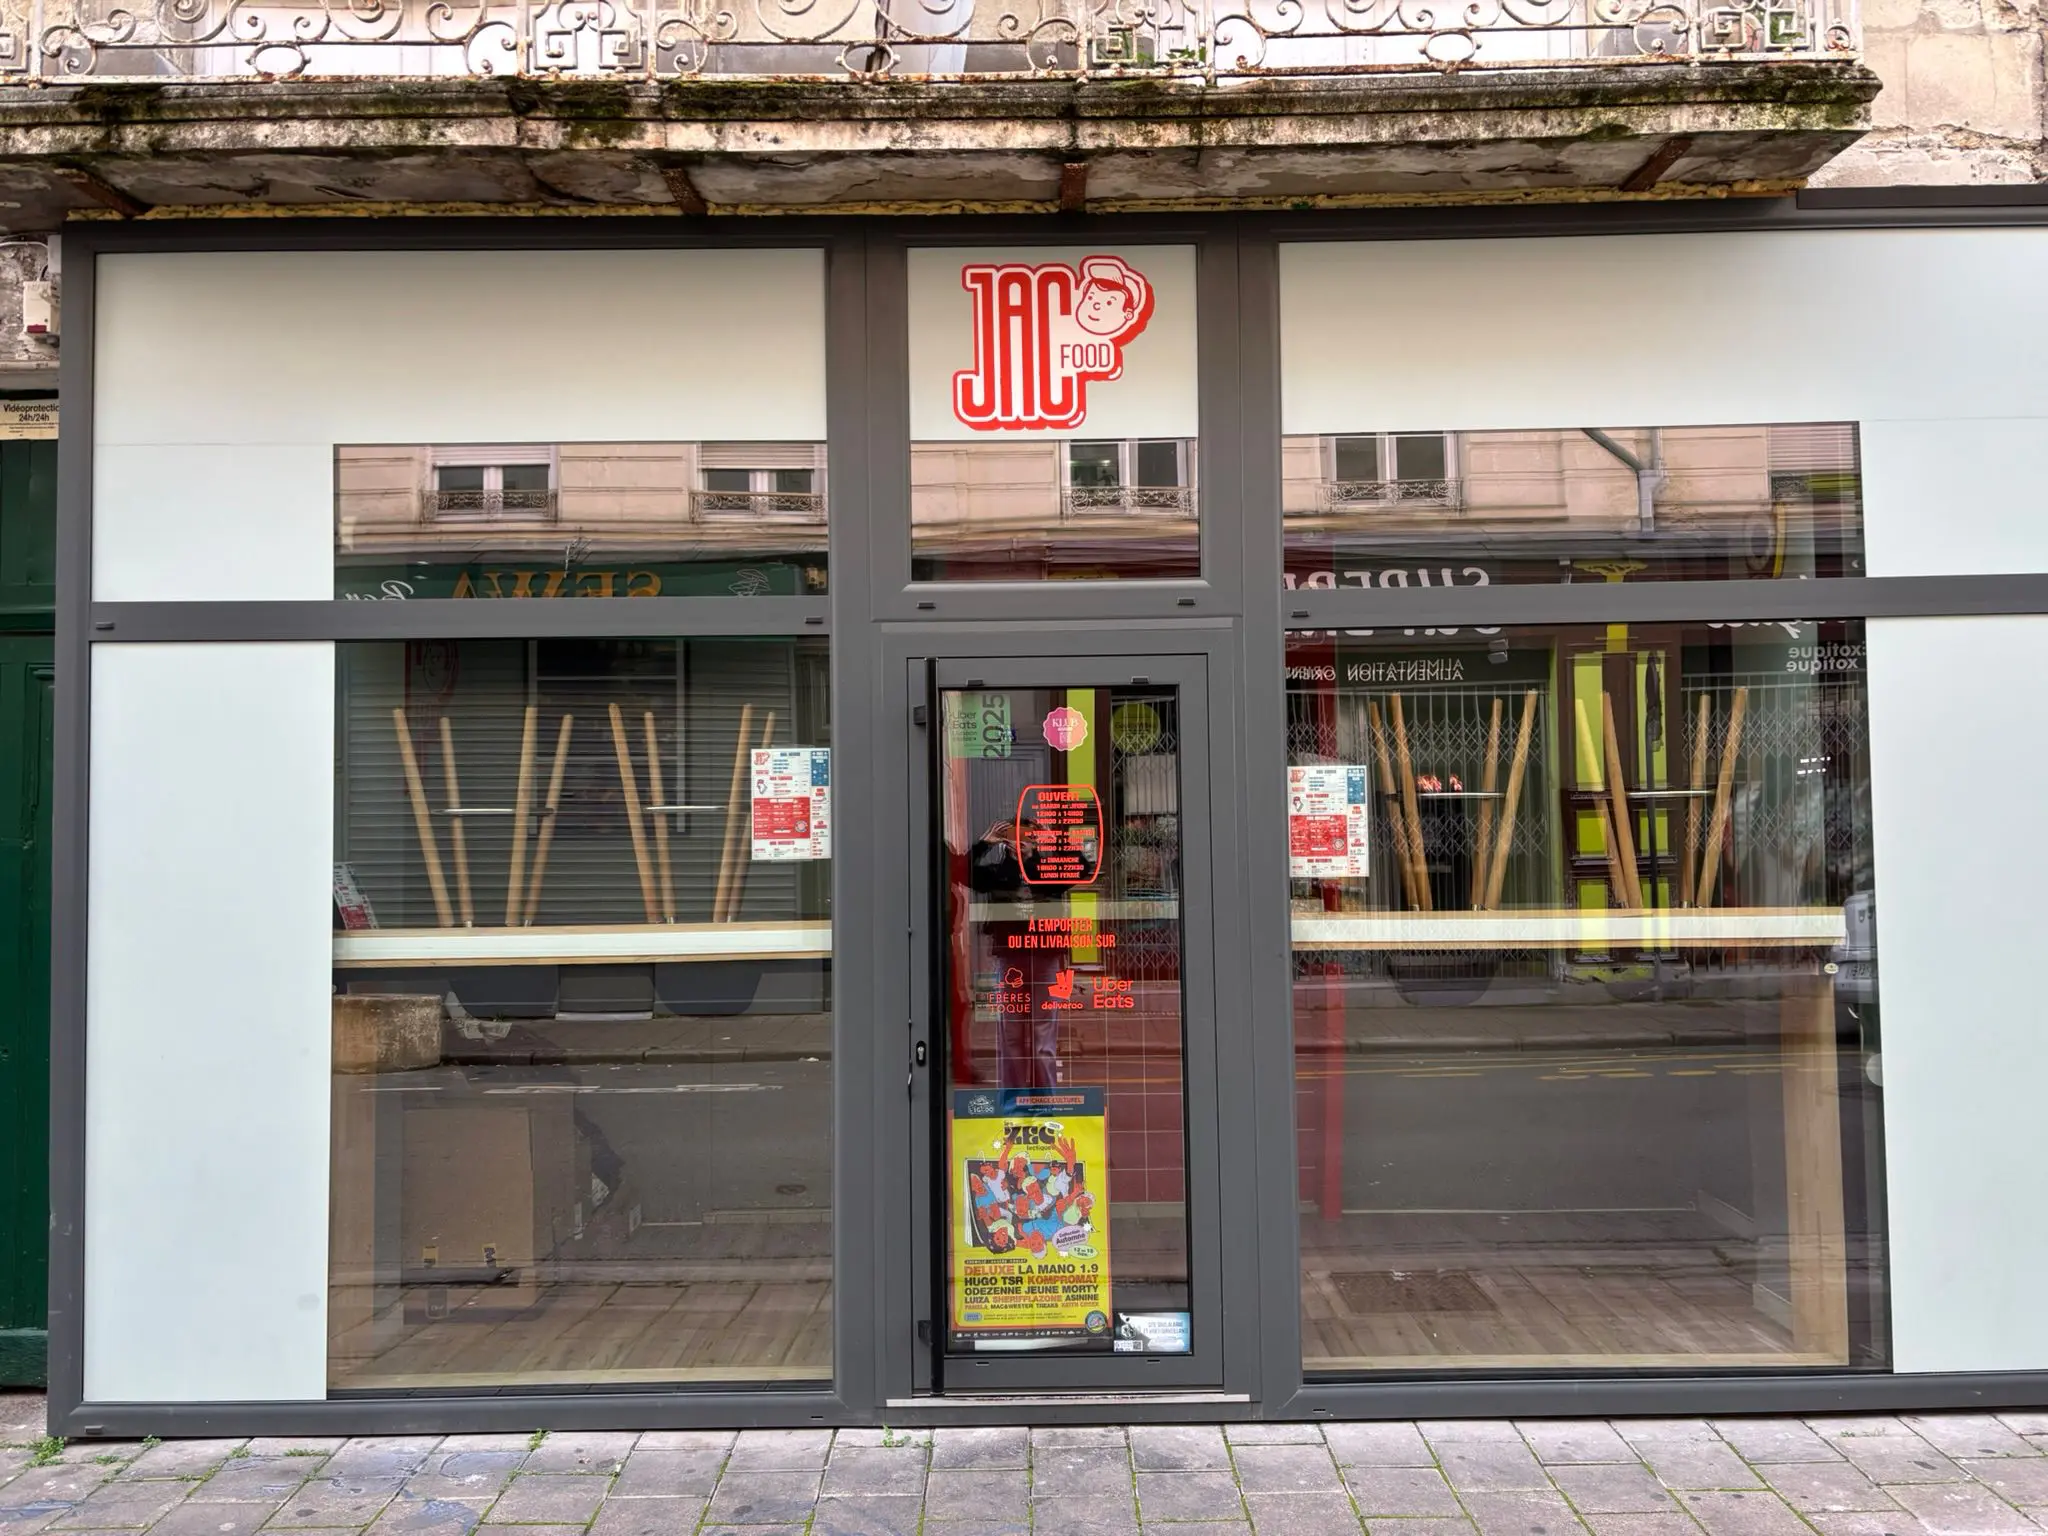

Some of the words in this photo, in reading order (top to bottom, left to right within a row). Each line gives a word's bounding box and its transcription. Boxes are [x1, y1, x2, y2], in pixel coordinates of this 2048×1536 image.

[960, 270, 1075, 418] JAC
[1059, 342, 1111, 369] FOOD
[18, 413, 50, 422] 24h/24h
[952, 721, 977, 729] Eats
[982, 694, 1005, 758] 2025
[1037, 792, 1079, 801] OUVERT
[1028, 916, 1036, 932] À
[1038, 918, 1093, 932] EMPORTER
[1008, 935, 1022, 949] OU
[1024, 935, 1038, 948] EN
[1040, 934, 1092, 948] LIVRAISON
[1095, 934, 1116, 948] SUR
[1092, 976, 1134, 992] Uber
[1041, 1001, 1083, 1010] deliveroo
[1093, 994, 1135, 1009] Eats
[989, 1004, 1031, 1014] TOQUE
[1056, 1233, 1086, 1244] Automne
[964, 1265, 1015, 1276] DELUXE
[1018, 1265, 1034, 1275] LA
[1038, 1264, 1076, 1274] MANO
[1080, 1263, 1099, 1273] 1.9
[964, 1276, 998, 1286] HUGO
[1001, 1276, 1023, 1285] TSR
[1027, 1274, 1099, 1285] KOMPROMAT
[964, 1286, 1022, 1295] ODEZENNE
[1024, 1285, 1059, 1294] JEUNE
[1062, 1284, 1099, 1293] MORTY
[964, 1296, 990, 1304] LUIZA
[1065, 1293, 1099, 1302] ASININE
